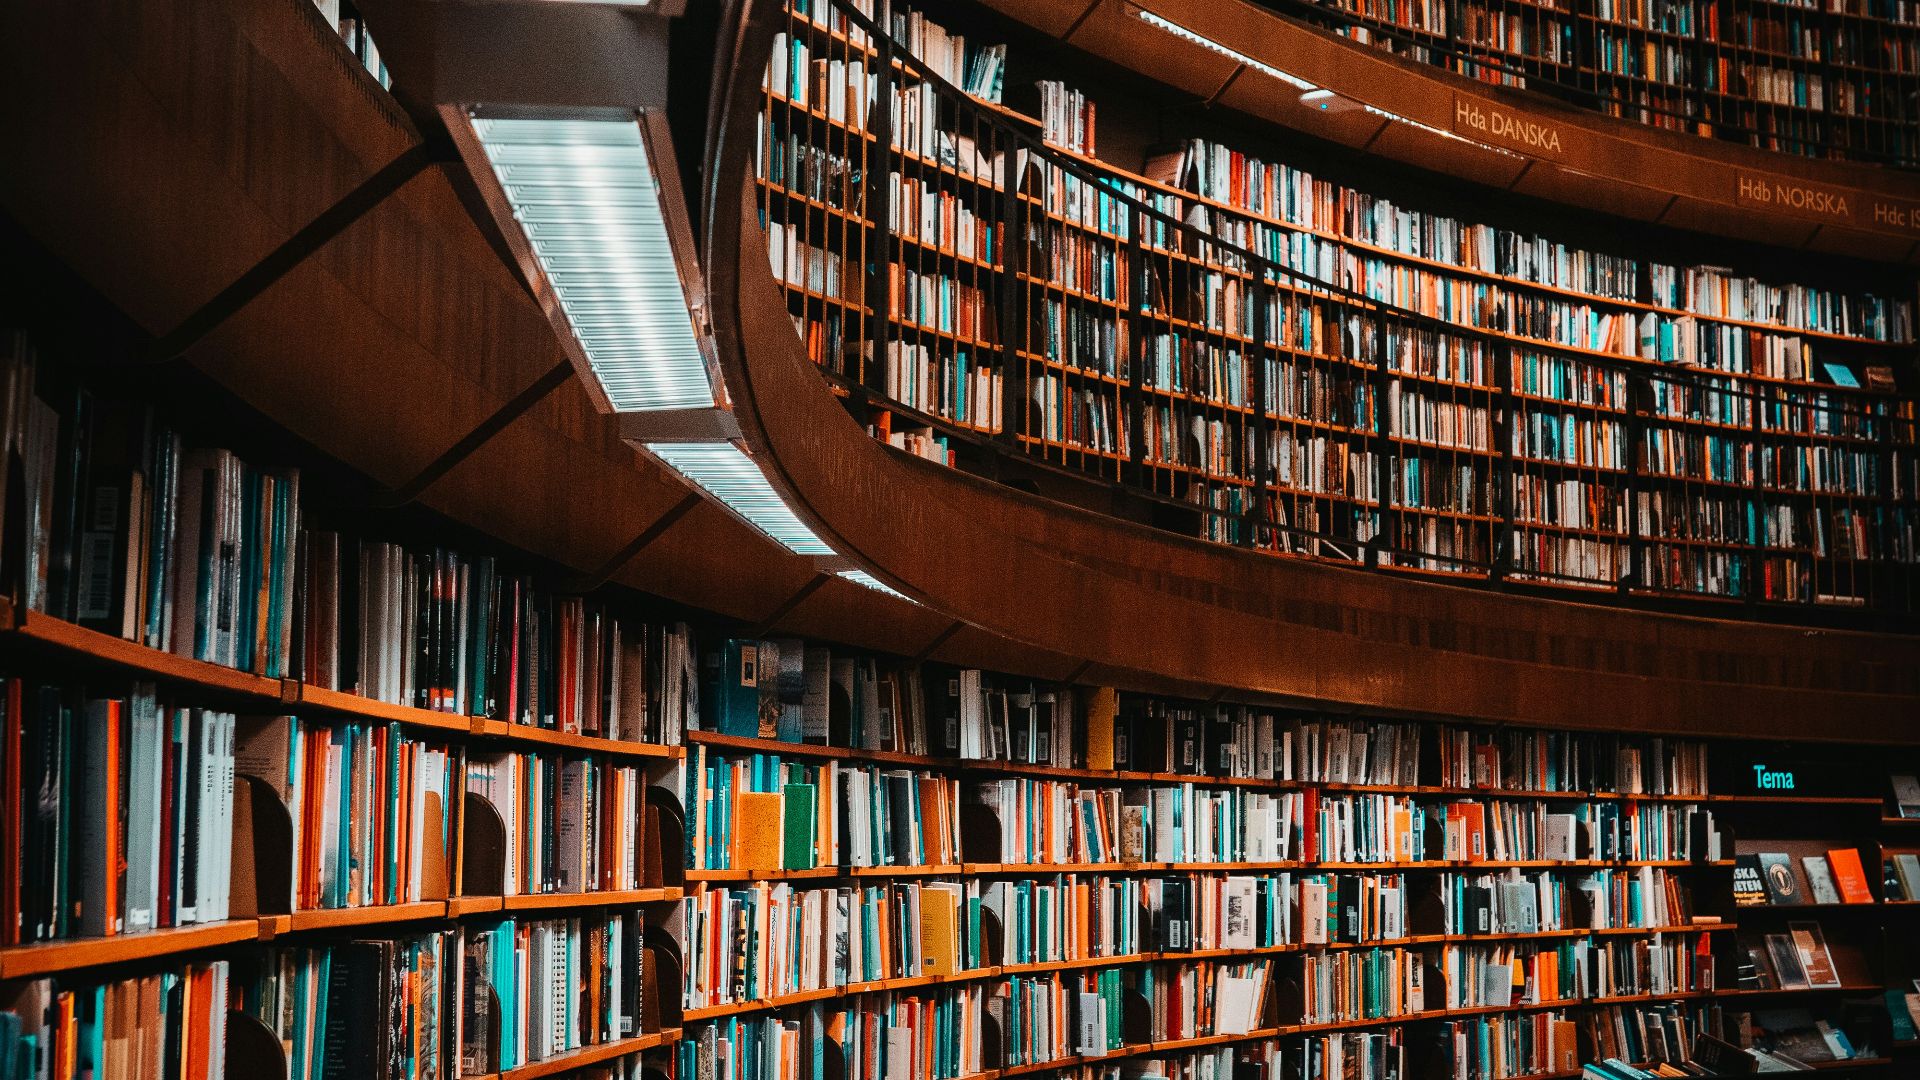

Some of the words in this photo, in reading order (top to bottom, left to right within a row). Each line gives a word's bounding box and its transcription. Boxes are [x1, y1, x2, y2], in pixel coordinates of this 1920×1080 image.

[1457, 100, 1486, 131] Hda
[1491, 112, 1561, 152] DANSKA
[1739, 177, 1771, 202] Hdb
[1776, 184, 1849, 216] NORSKA
[1874, 203, 1905, 226] Hdc
[1753, 764, 1795, 789] Tema
[1734, 867, 1758, 879] SKA
